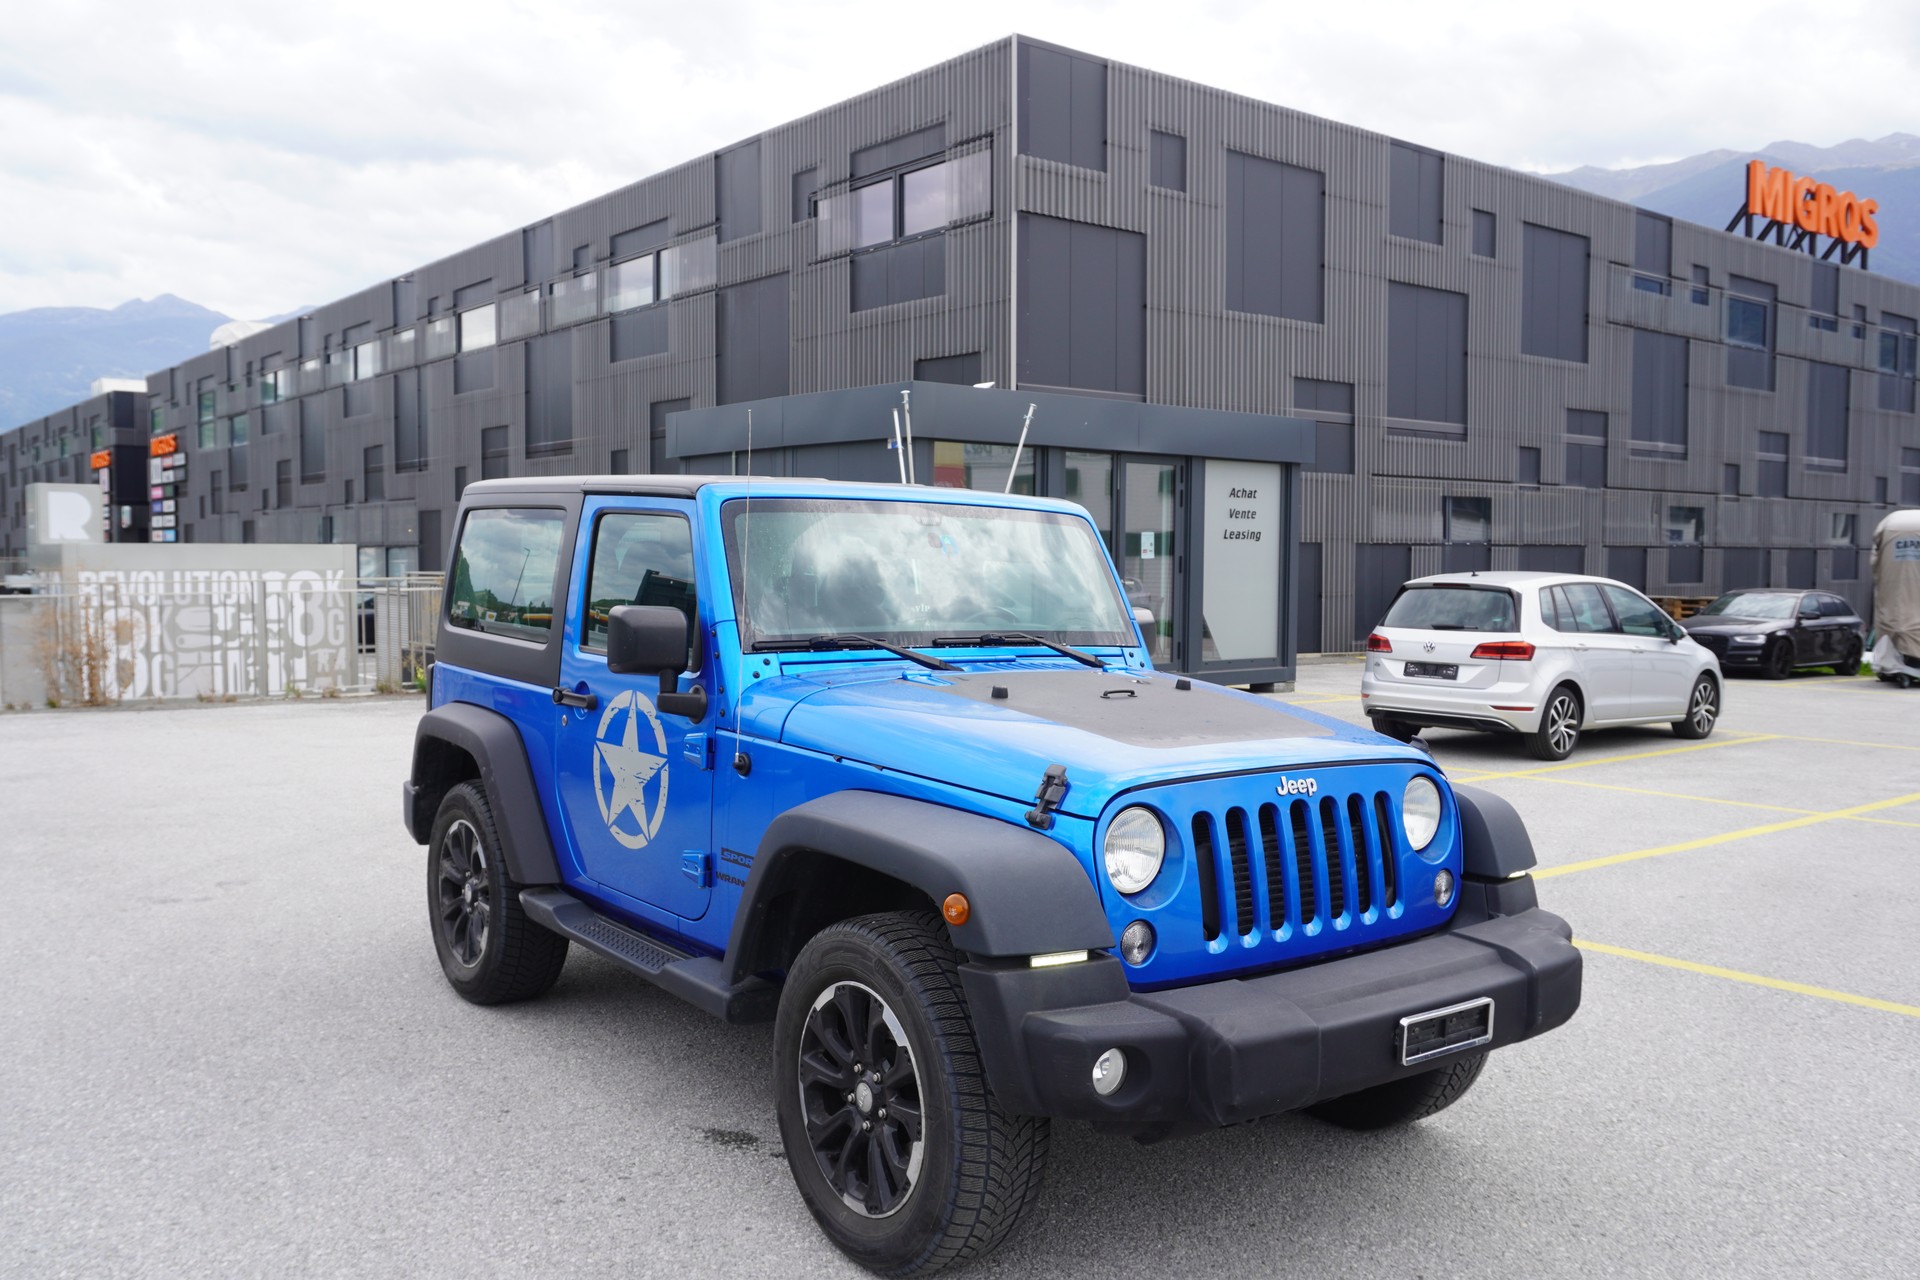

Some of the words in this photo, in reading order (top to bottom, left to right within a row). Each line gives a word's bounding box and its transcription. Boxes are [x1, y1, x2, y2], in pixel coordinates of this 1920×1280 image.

[1748, 159, 1880, 249] MIGROS
[1229, 487, 1258, 499] Achat
[1229, 508, 1257, 519] Vente
[1223, 529, 1262, 542] Leasing
[78, 570, 259, 607] REVOLUTION
[1276, 775, 1318, 797] Jeep
[722, 851, 754, 867] SPOR
